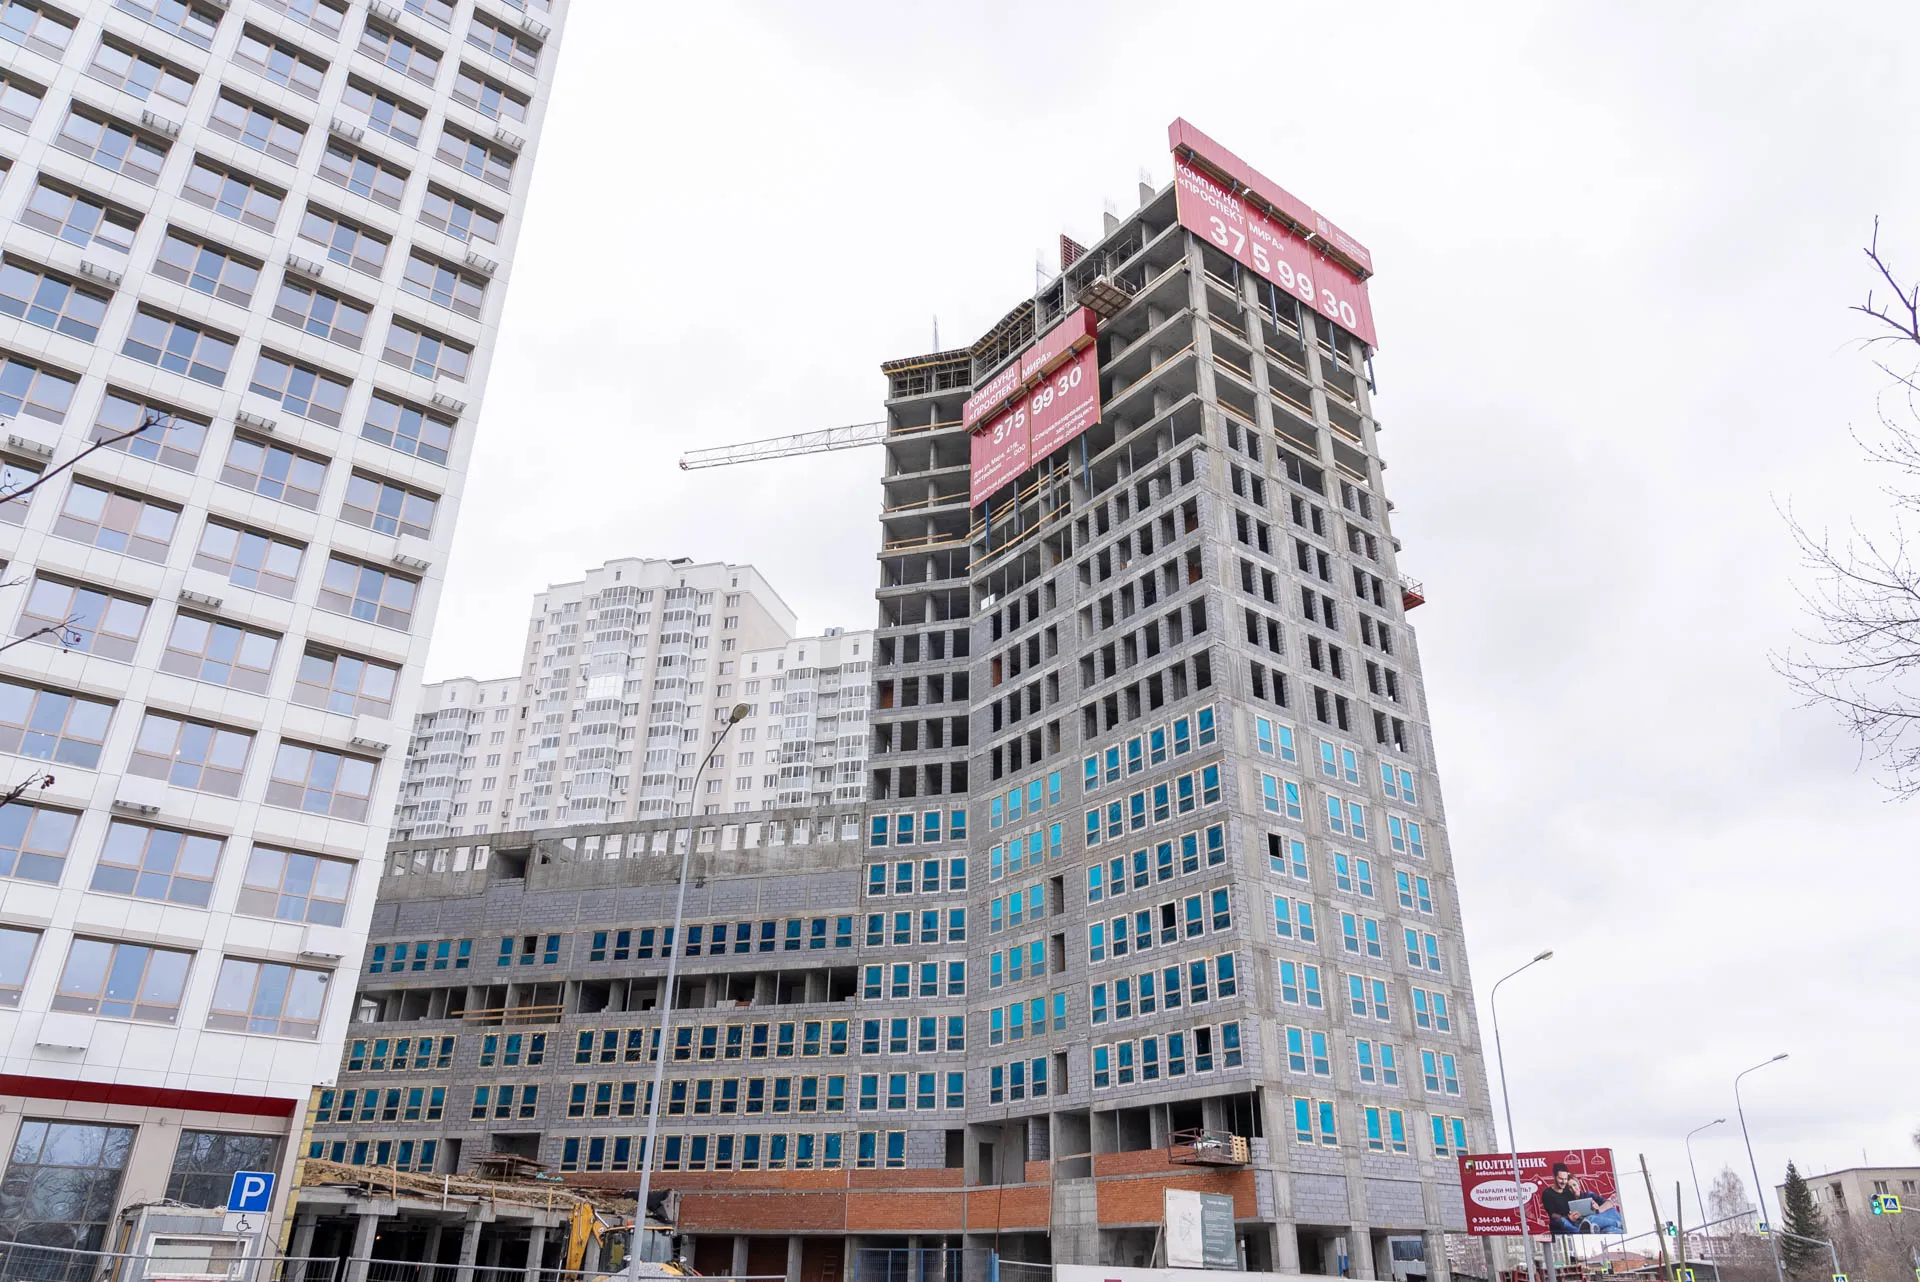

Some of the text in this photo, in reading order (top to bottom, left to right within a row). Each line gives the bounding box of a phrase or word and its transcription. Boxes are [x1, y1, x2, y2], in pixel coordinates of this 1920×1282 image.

[1176, 161, 1241, 212] КОМПАУНД
[1178, 177, 1285, 251] «ПРОСПЕКТ МИРА»
[1209, 215, 1356, 329] 375 99 30
[968, 351, 1052, 421] «ПРОСПЕКТ МИРА»
[968, 365, 1014, 410] КОМПАУНД
[993, 366, 1082, 445] 375 99 30
[1013, 444, 1026, 456] ООО
[239, 1176, 266, 1208] P
[1474, 1225, 1522, 1233] ПРОФСОЮЗНАЯ,
